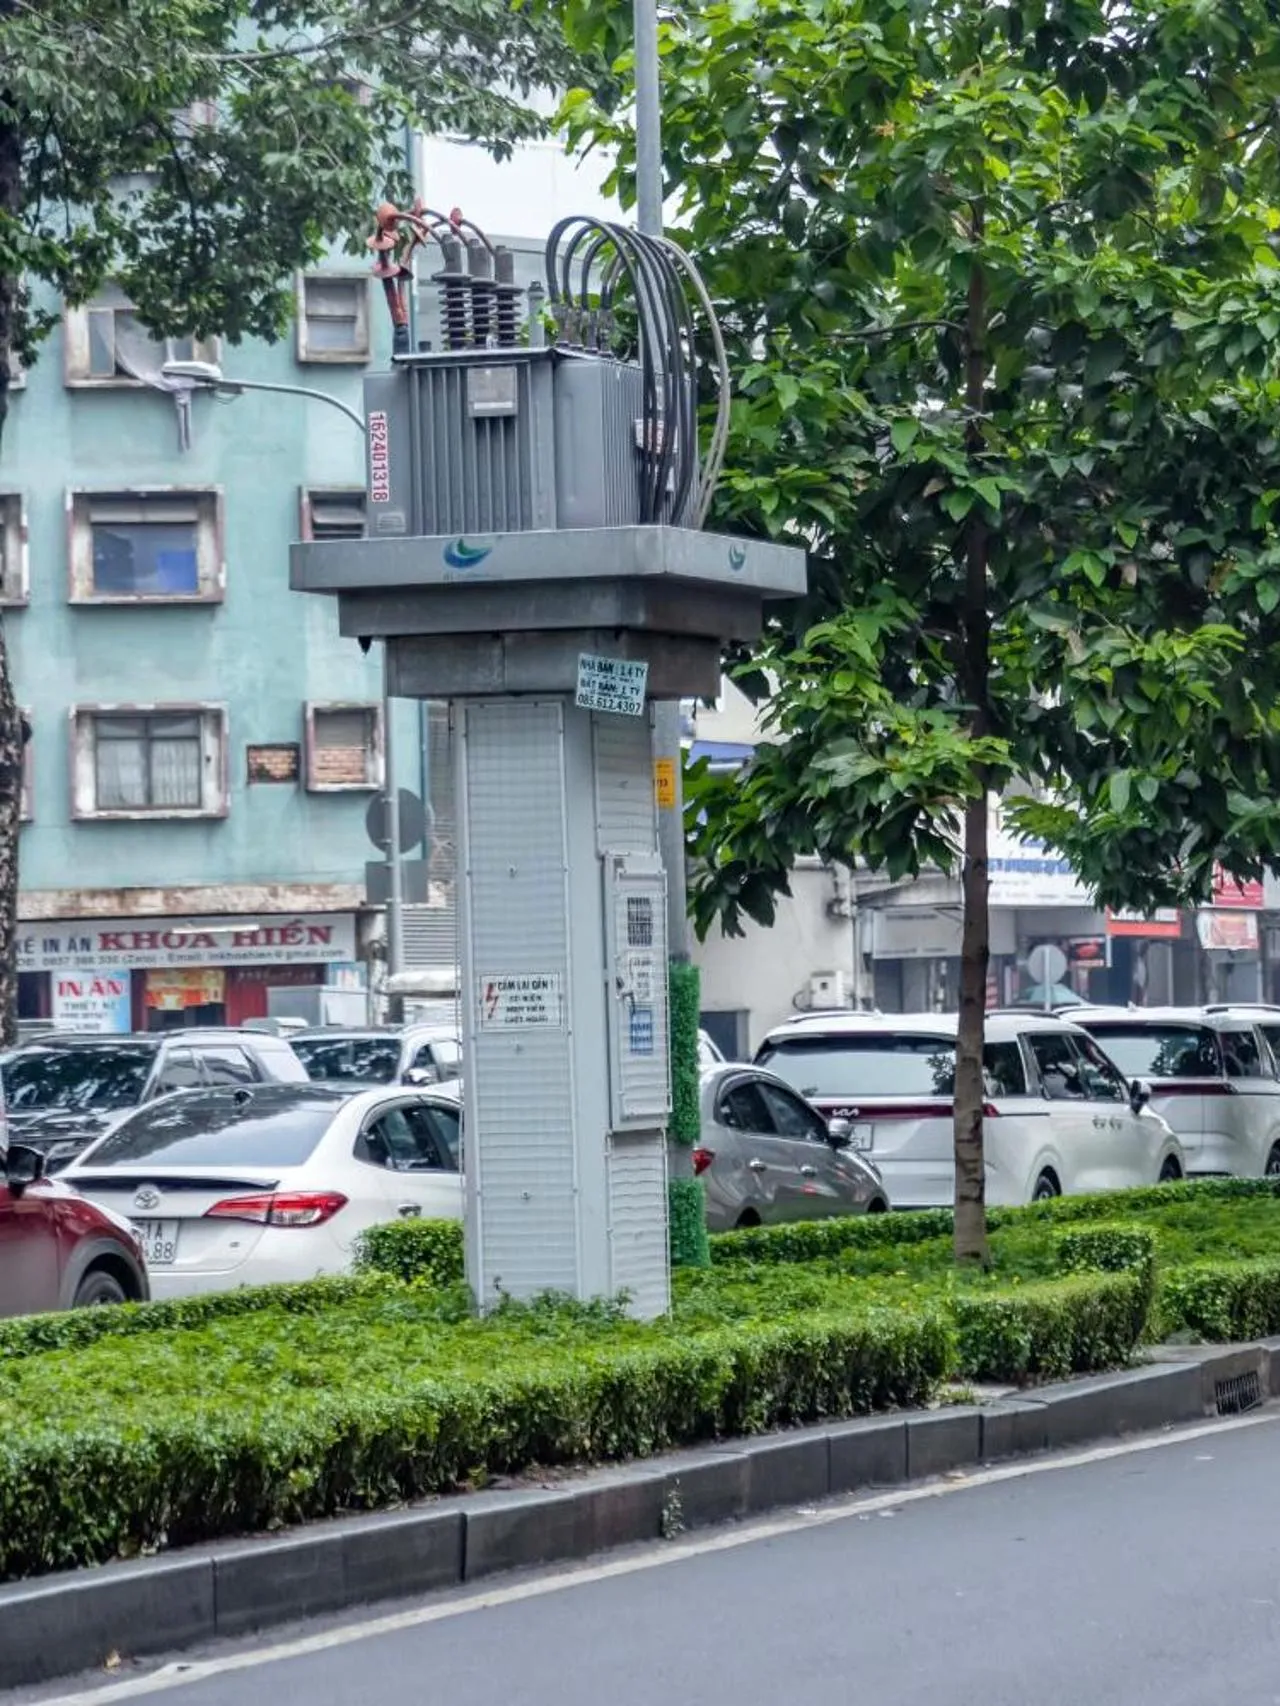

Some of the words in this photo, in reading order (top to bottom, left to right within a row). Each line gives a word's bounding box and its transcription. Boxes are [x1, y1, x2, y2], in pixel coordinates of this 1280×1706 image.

[371, 413, 388, 501] 162401318
[42, 937, 61, 953] IN
[97, 930, 218, 951] KHOA
[57, 980, 83, 997] IN
